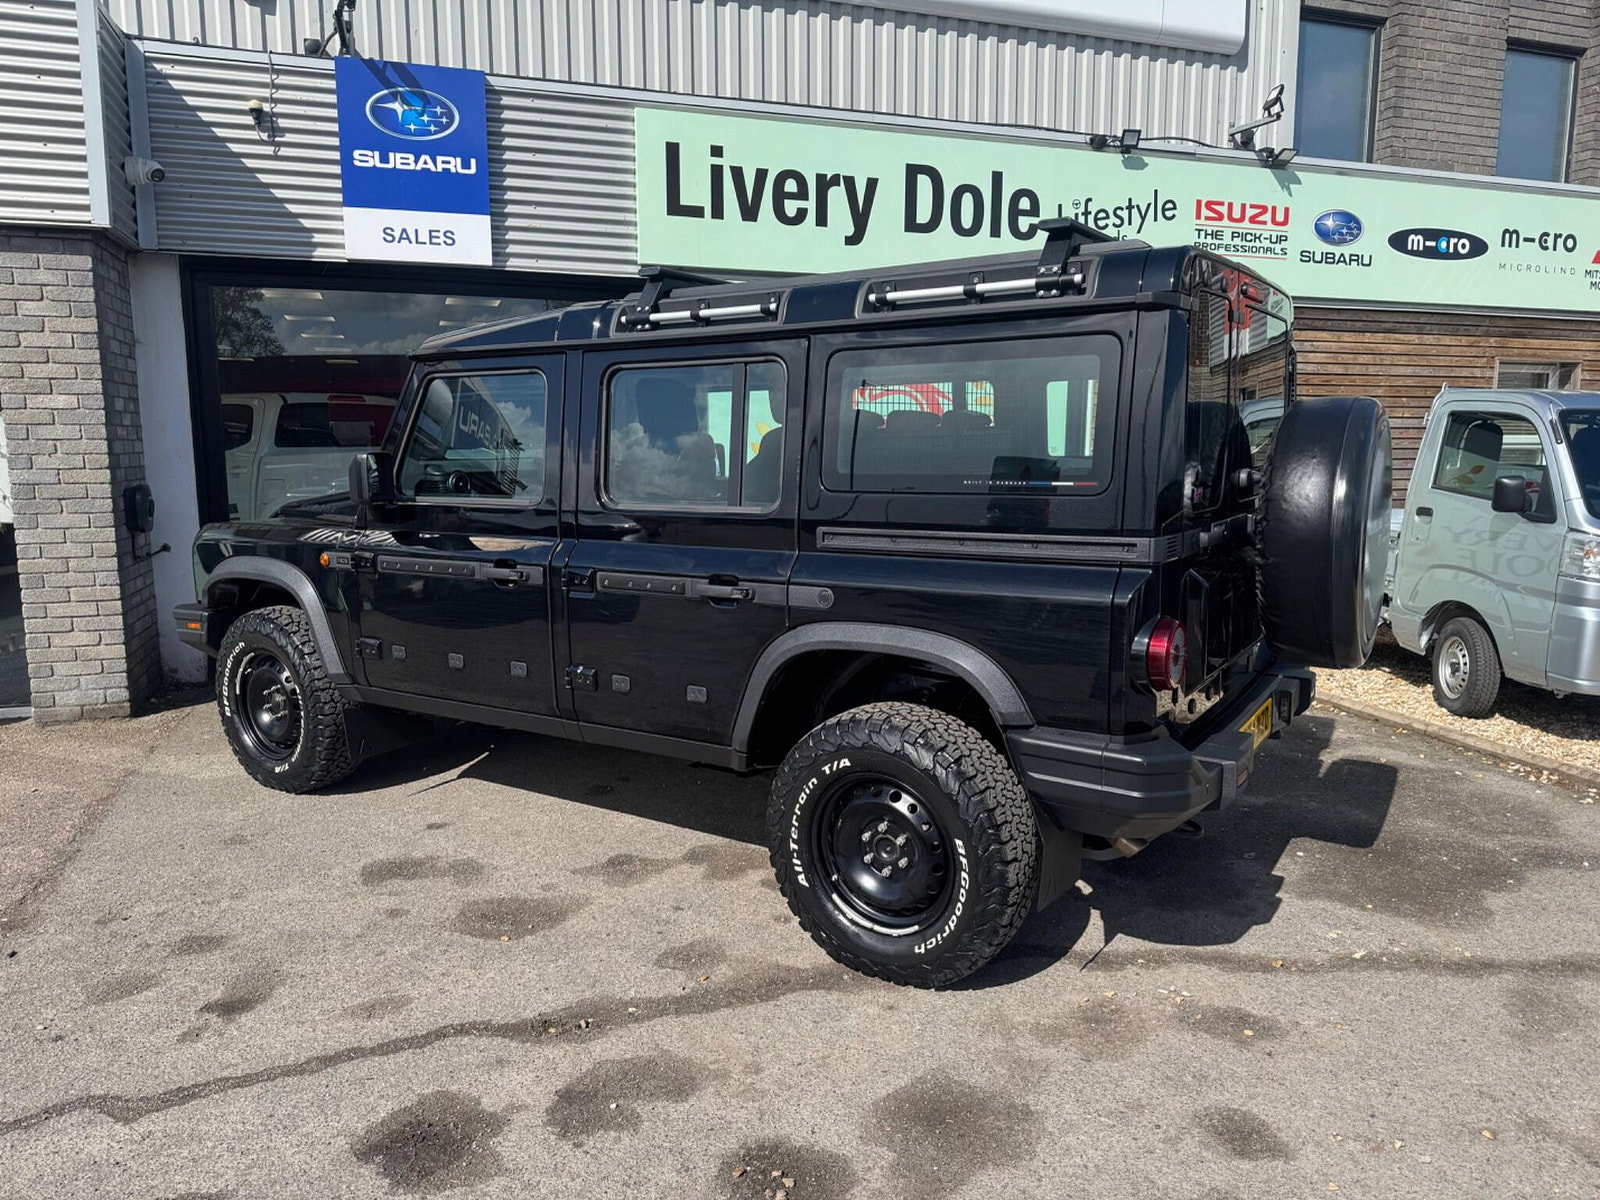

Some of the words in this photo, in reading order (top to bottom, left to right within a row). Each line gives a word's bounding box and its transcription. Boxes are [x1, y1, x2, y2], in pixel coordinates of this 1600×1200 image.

[352, 149, 477, 175] SUBARU
[665, 141, 879, 246] Livery
[904, 163, 1041, 241] Dole
[1195, 199, 1290, 226] ISUZU
[382, 226, 456, 247] SALES
[1195, 228, 1224, 240] THE
[1231, 231, 1288, 245] PICK-UP
[1194, 242, 1288, 256] PROFESSIONALS
[1299, 250, 1373, 267] SUBARU
[1498, 262, 1577, 276] MICROLINO
[1584, 269, 1600, 280] MIT
[222, 641, 246, 718] BFGoodrich
[789, 777, 818, 888] All-Terrain
[821, 757, 852, 776] T/A
[914, 837, 970, 955] BFGoodrich
